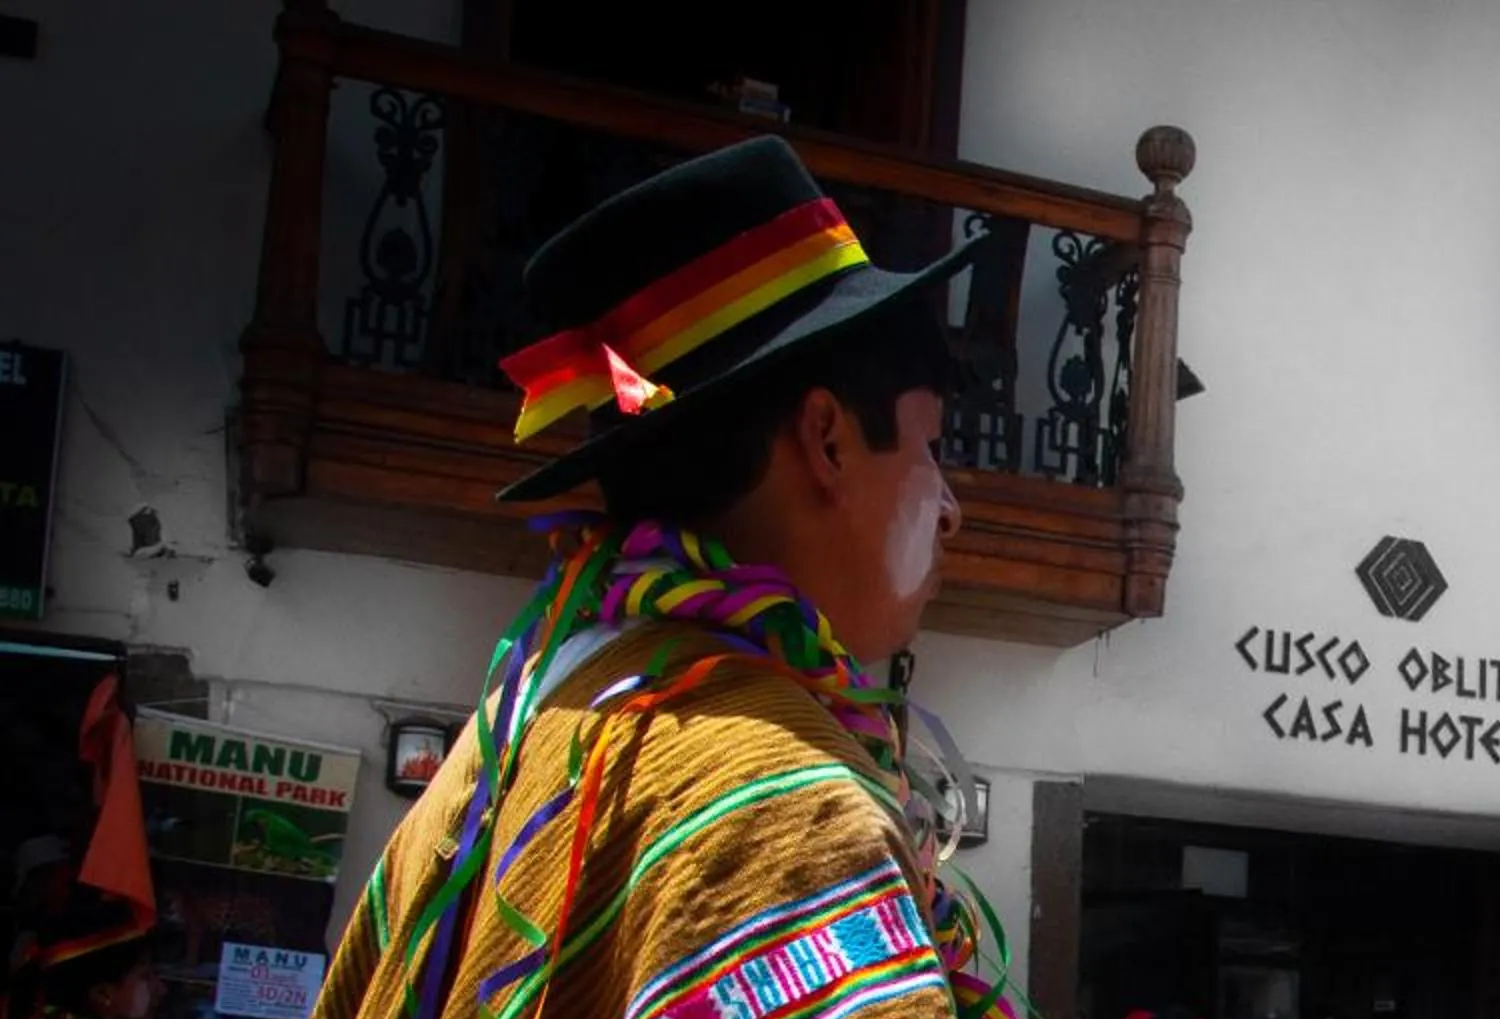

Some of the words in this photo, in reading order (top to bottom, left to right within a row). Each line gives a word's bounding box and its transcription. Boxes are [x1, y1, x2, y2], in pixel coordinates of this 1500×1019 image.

[1234, 626, 1370, 685] CUSCO
[1263, 693, 1374, 747] CASA
[170, 729, 322, 783] MANU
[139, 760, 270, 797] NATIONAL
[275, 780, 347, 808] PARK
[233, 946, 308, 969] MANU
